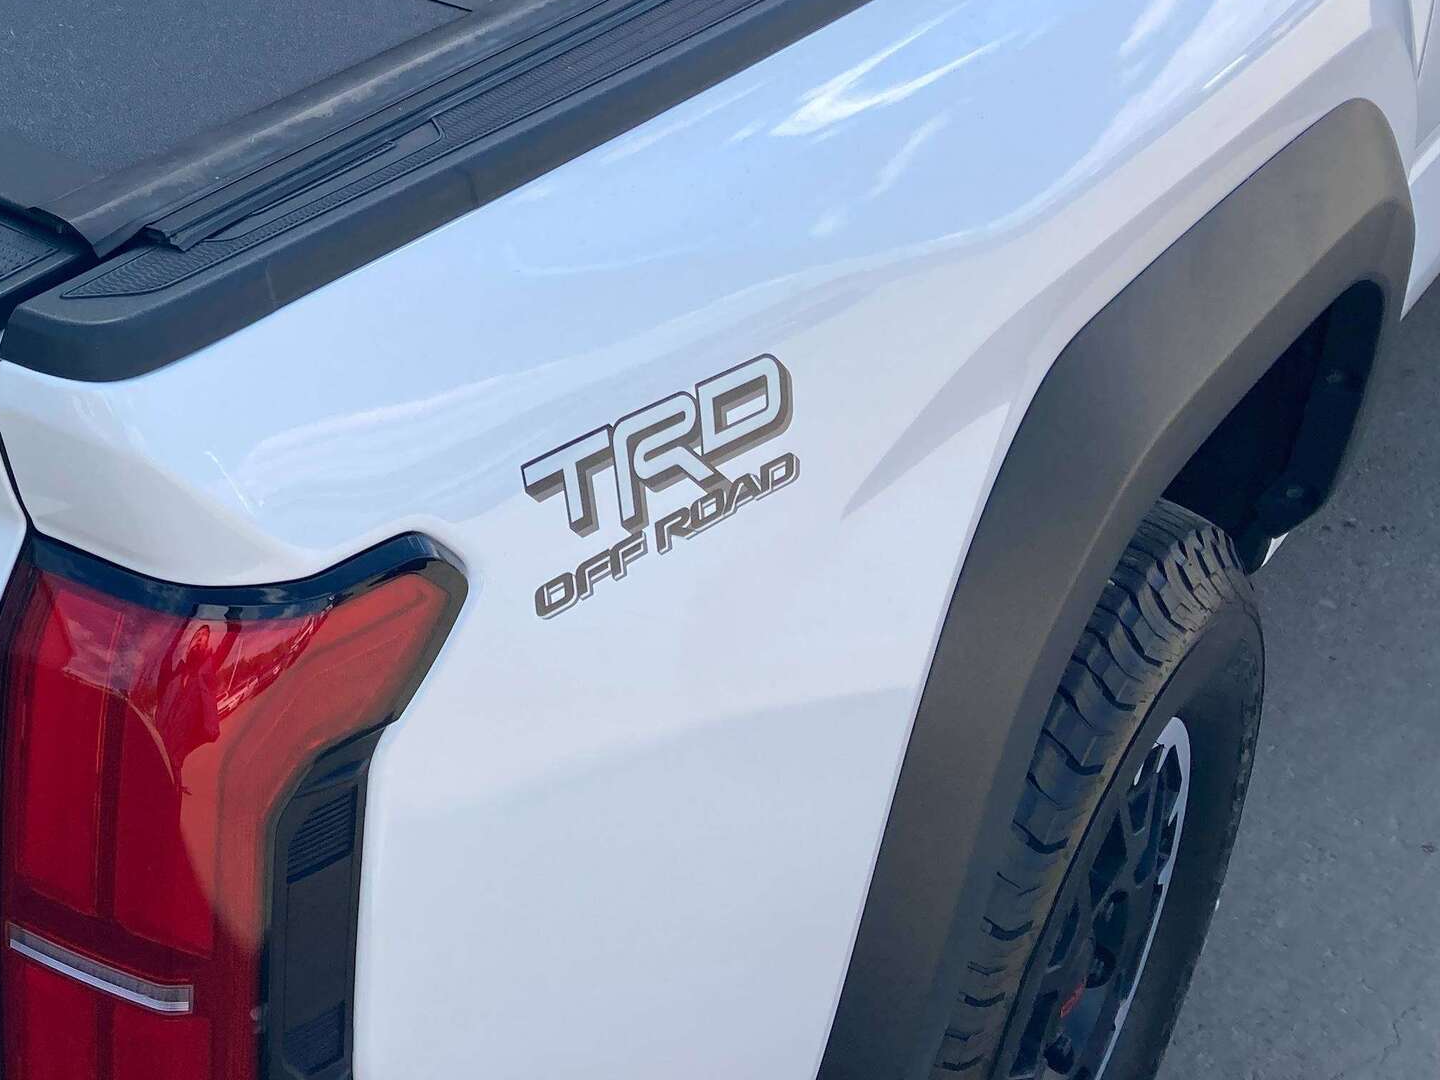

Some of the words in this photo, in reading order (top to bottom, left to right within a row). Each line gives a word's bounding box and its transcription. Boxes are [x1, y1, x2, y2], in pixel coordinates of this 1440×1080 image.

[520, 352, 794, 538] TRD
[534, 530, 648, 620] OFF
[654, 452, 800, 555] ROAD
